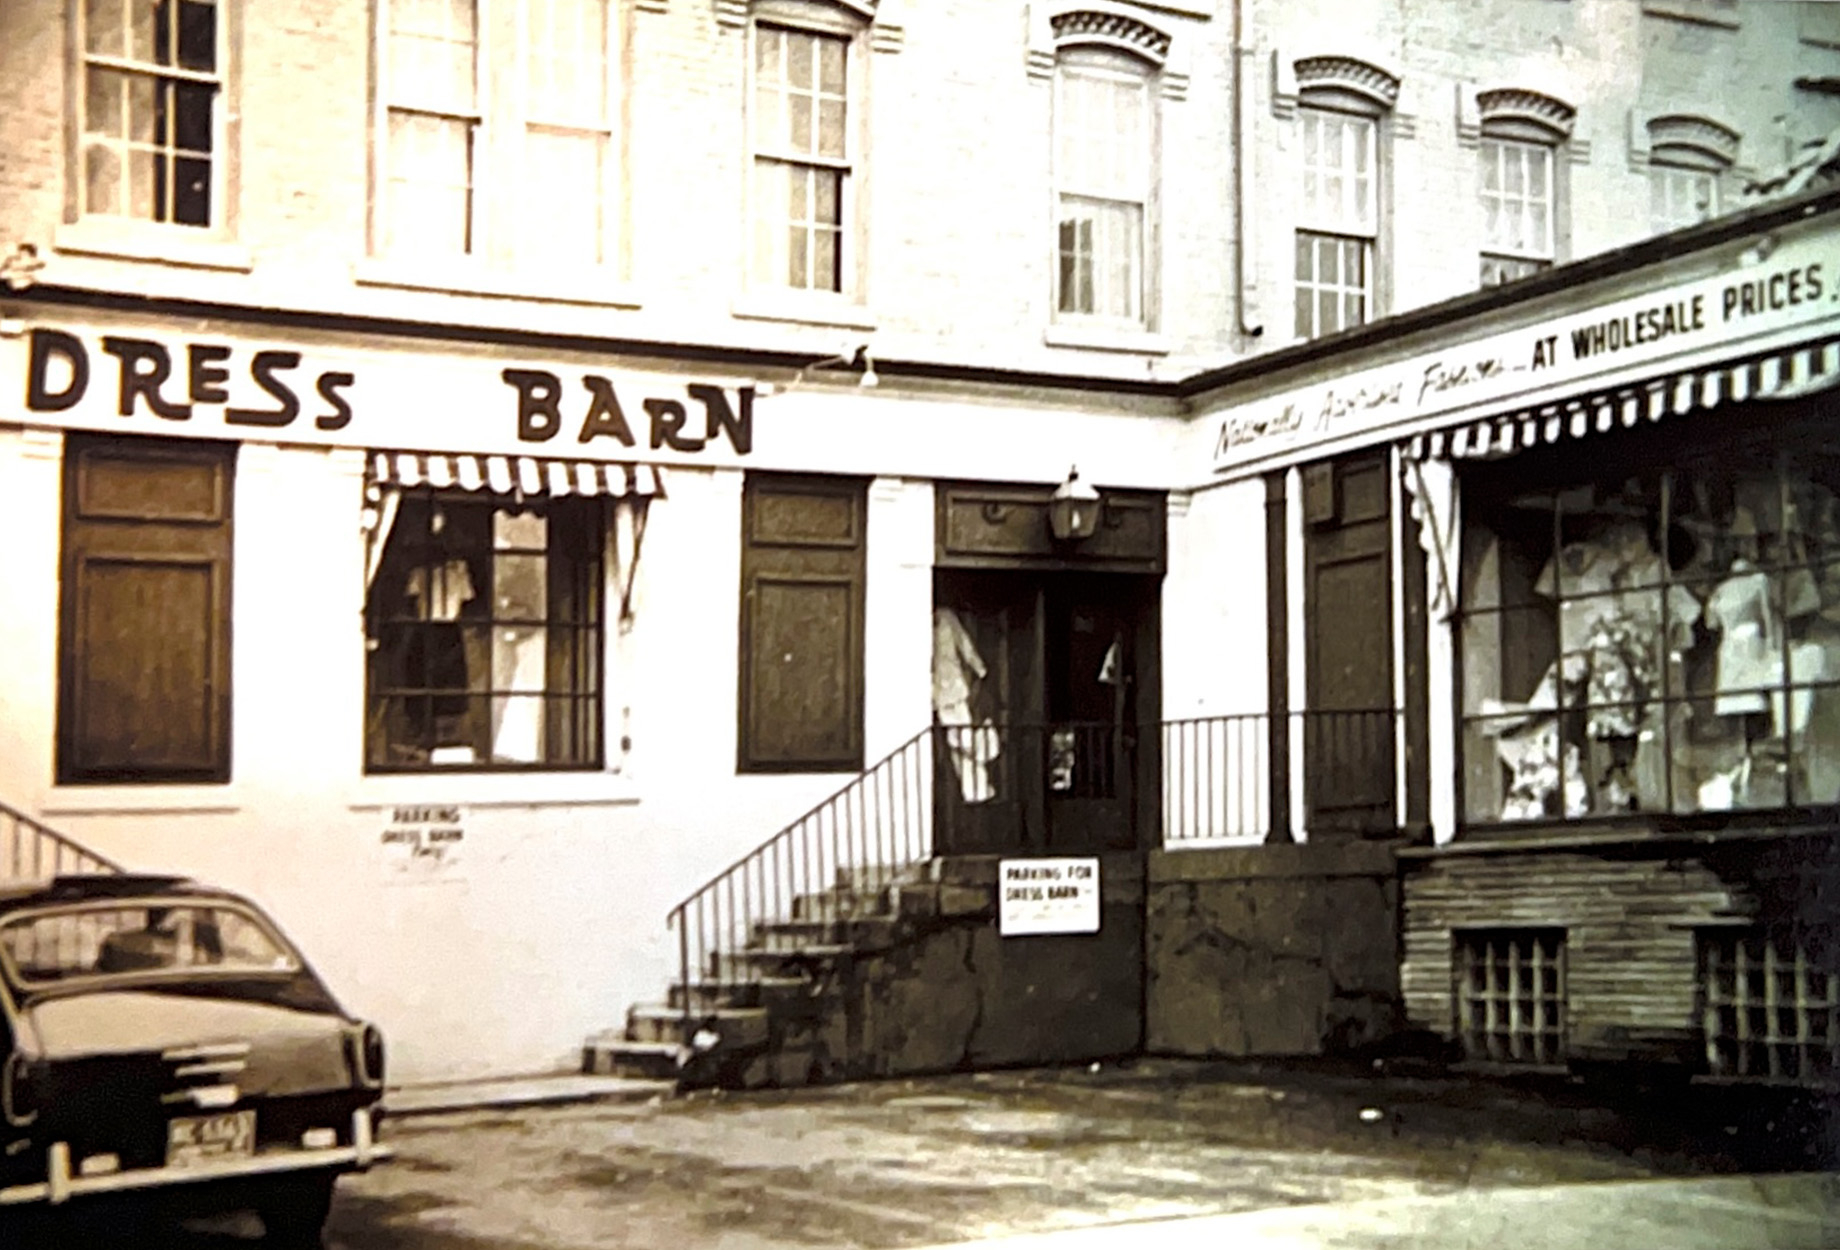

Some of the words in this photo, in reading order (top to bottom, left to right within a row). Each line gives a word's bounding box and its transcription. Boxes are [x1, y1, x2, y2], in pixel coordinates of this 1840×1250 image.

[1532, 335, 1558, 372] AT
[1571, 294, 1705, 360] WHOLESALE
[25, 327, 356, 431] DRESS
[501, 367, 756, 456] BARN
[1006, 866, 1062, 881] PARKING
[1068, 865, 1092, 880] FOR
